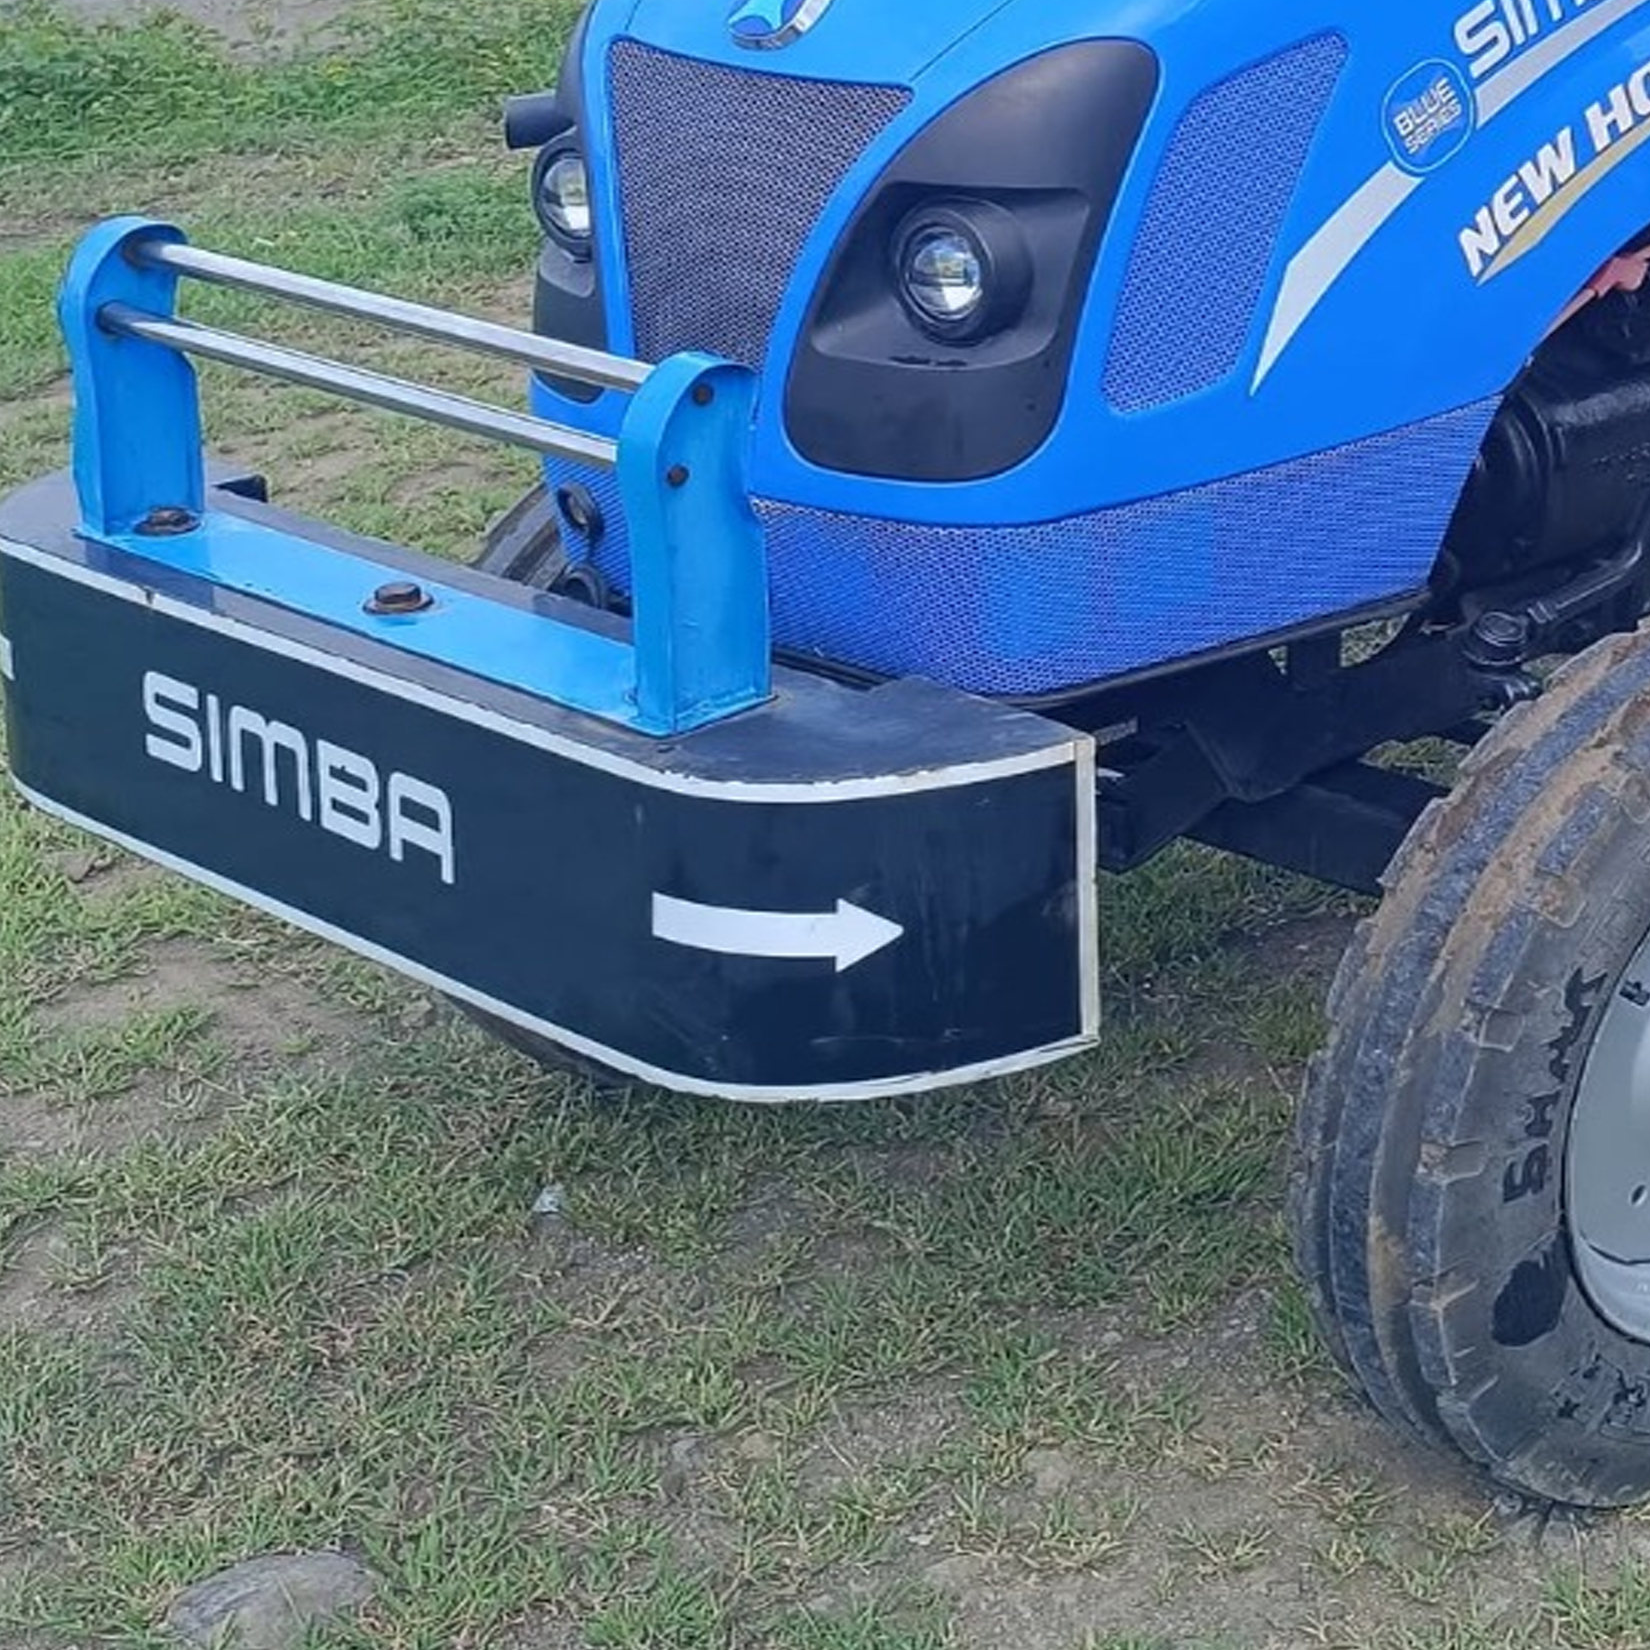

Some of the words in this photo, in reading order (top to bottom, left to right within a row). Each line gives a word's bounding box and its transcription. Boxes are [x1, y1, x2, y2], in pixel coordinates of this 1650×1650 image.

[1393, 77, 1456, 137] BLUE
[1457, 128, 1579, 278] NEW
[141, 670, 457, 885] SIMBA
